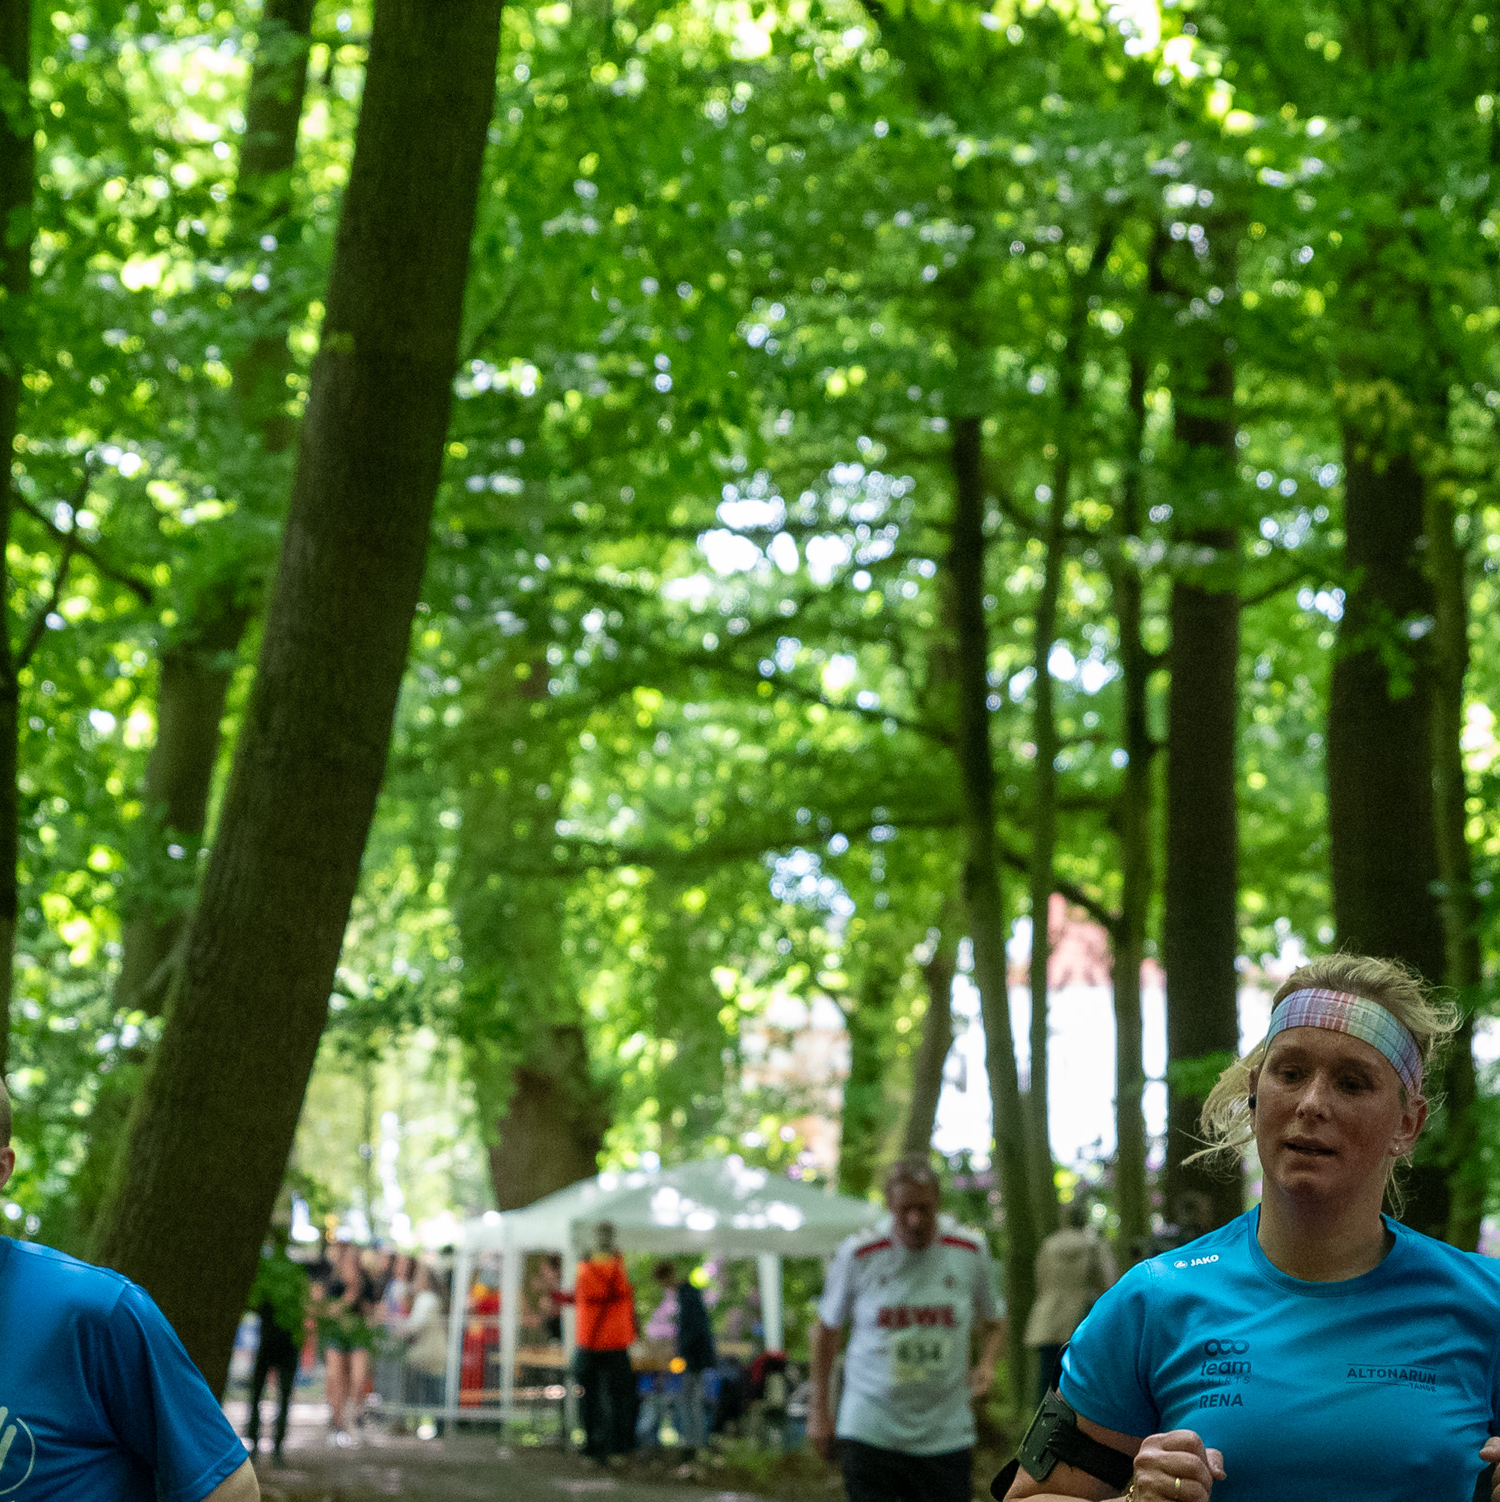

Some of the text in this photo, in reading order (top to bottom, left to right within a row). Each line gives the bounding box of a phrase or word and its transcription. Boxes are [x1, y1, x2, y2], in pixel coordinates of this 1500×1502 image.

[1190, 1254, 1219, 1267] JAKO
[877, 1306, 956, 1329] REWE
[1201, 1361, 1252, 1376] team
[1199, 1393, 1244, 1409] RENA
